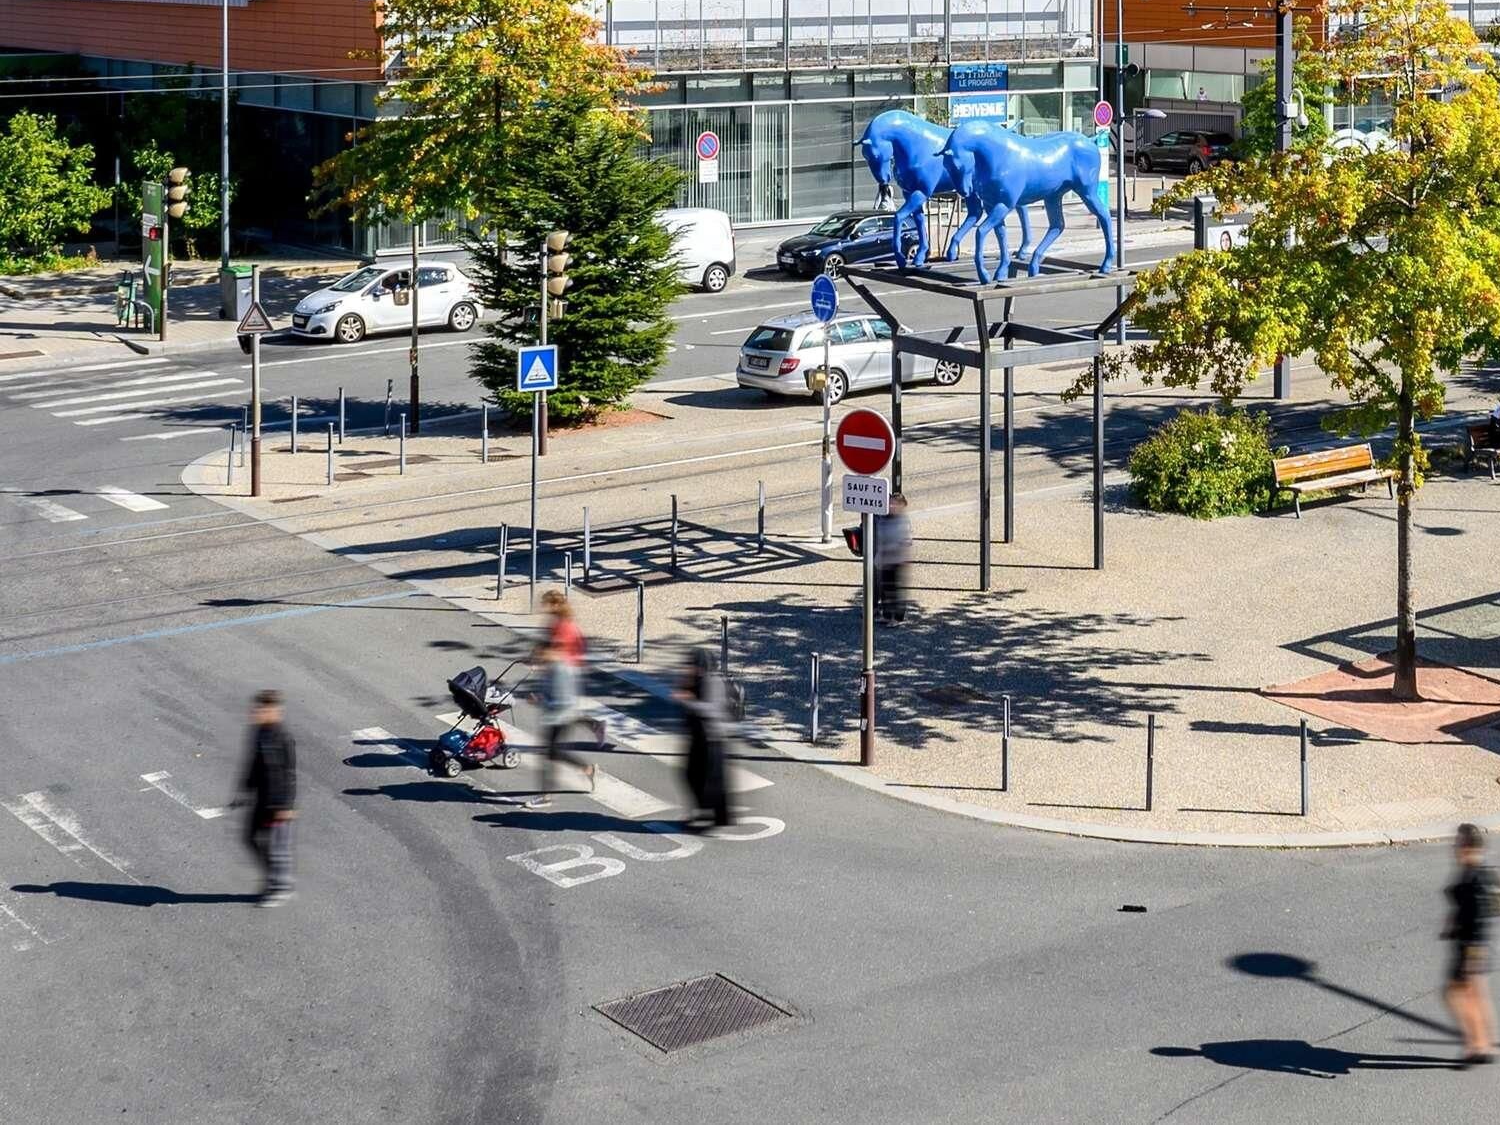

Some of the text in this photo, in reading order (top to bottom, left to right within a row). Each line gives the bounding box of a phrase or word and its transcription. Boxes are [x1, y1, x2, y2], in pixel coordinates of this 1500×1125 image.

[847, 482, 883, 493] SAUF TC
[846, 496, 883, 508] ET TAXIS
